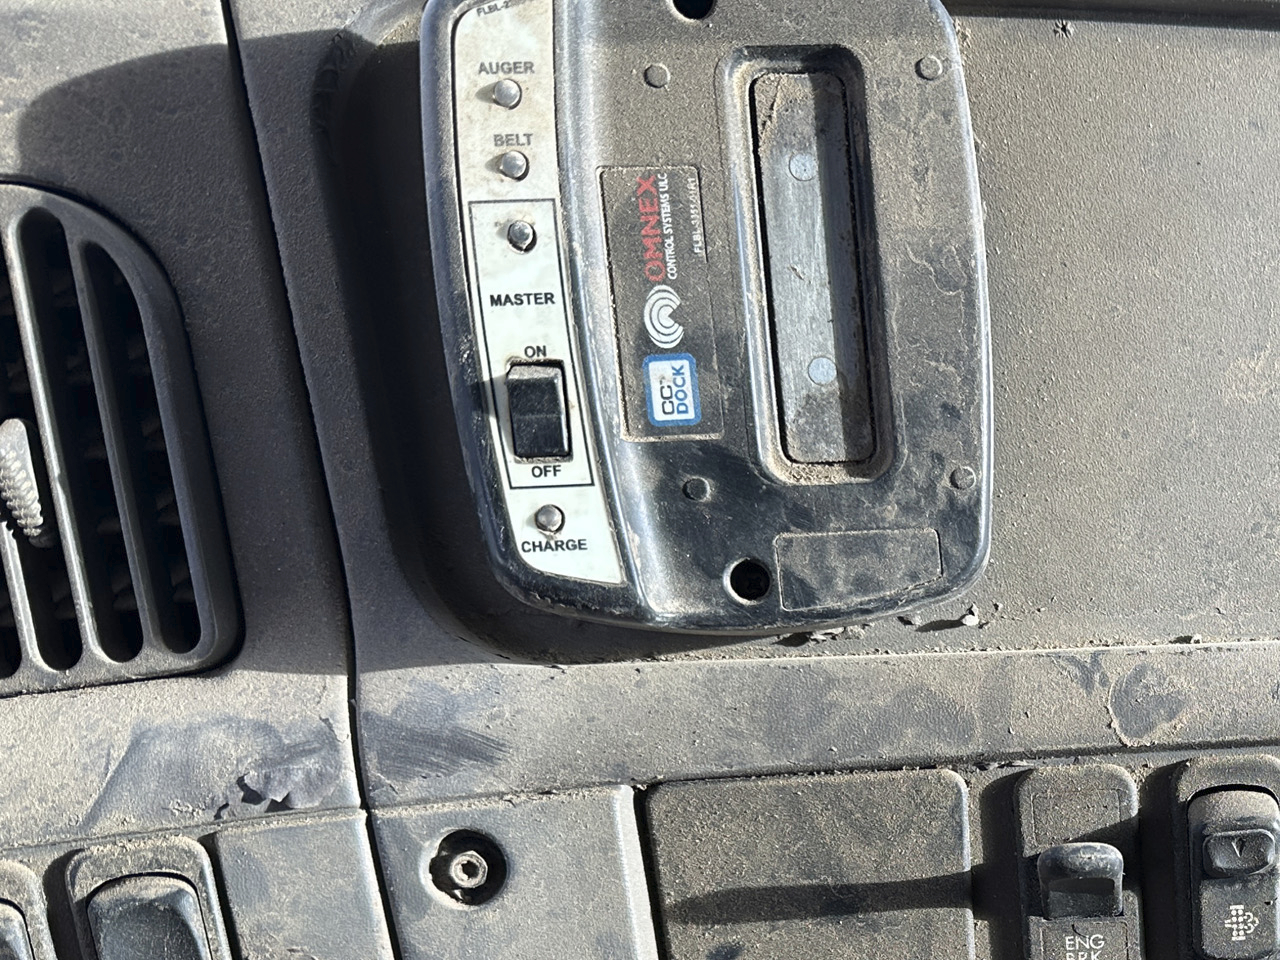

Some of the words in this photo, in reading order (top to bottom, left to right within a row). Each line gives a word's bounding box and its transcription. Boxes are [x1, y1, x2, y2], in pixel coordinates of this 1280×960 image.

[478, 61, 535, 75] AUGER
[493, 133, 533, 147] BELT
[657, 173, 668, 192] ULC
[660, 193, 674, 235] SYSTEMS
[636, 174, 667, 282] OMNEX
[663, 235, 677, 280] CONTROL
[489, 292, 556, 307] MASTER
[524, 344, 547, 358] ON
[671, 364, 689, 415] DOCK
[531, 465, 562, 478] OFF
[521, 538, 588, 553] CHARGE
[1065, 934, 1105, 950] ENG
